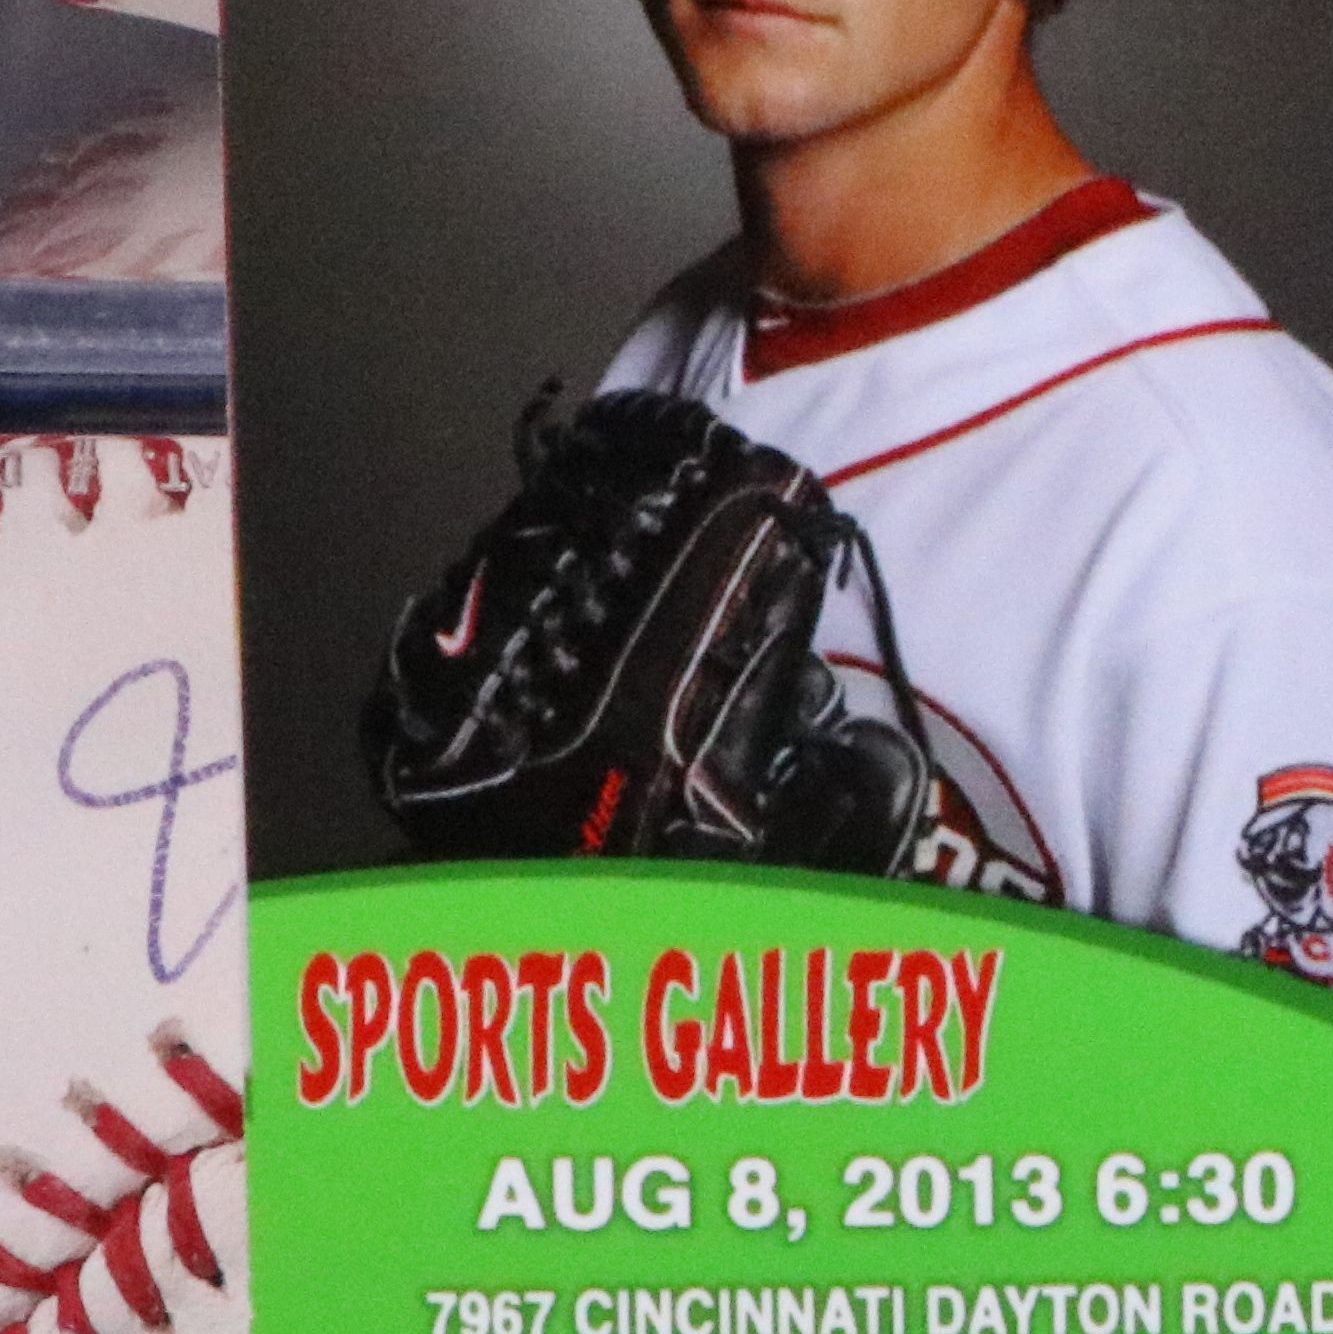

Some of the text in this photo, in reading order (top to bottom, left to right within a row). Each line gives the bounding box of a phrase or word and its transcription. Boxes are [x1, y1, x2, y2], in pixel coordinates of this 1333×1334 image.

[297, 945, 1003, 1109] SPORTS GALLERY
[477, 1151, 1296, 1242] AUG 8, 2013 6:30
